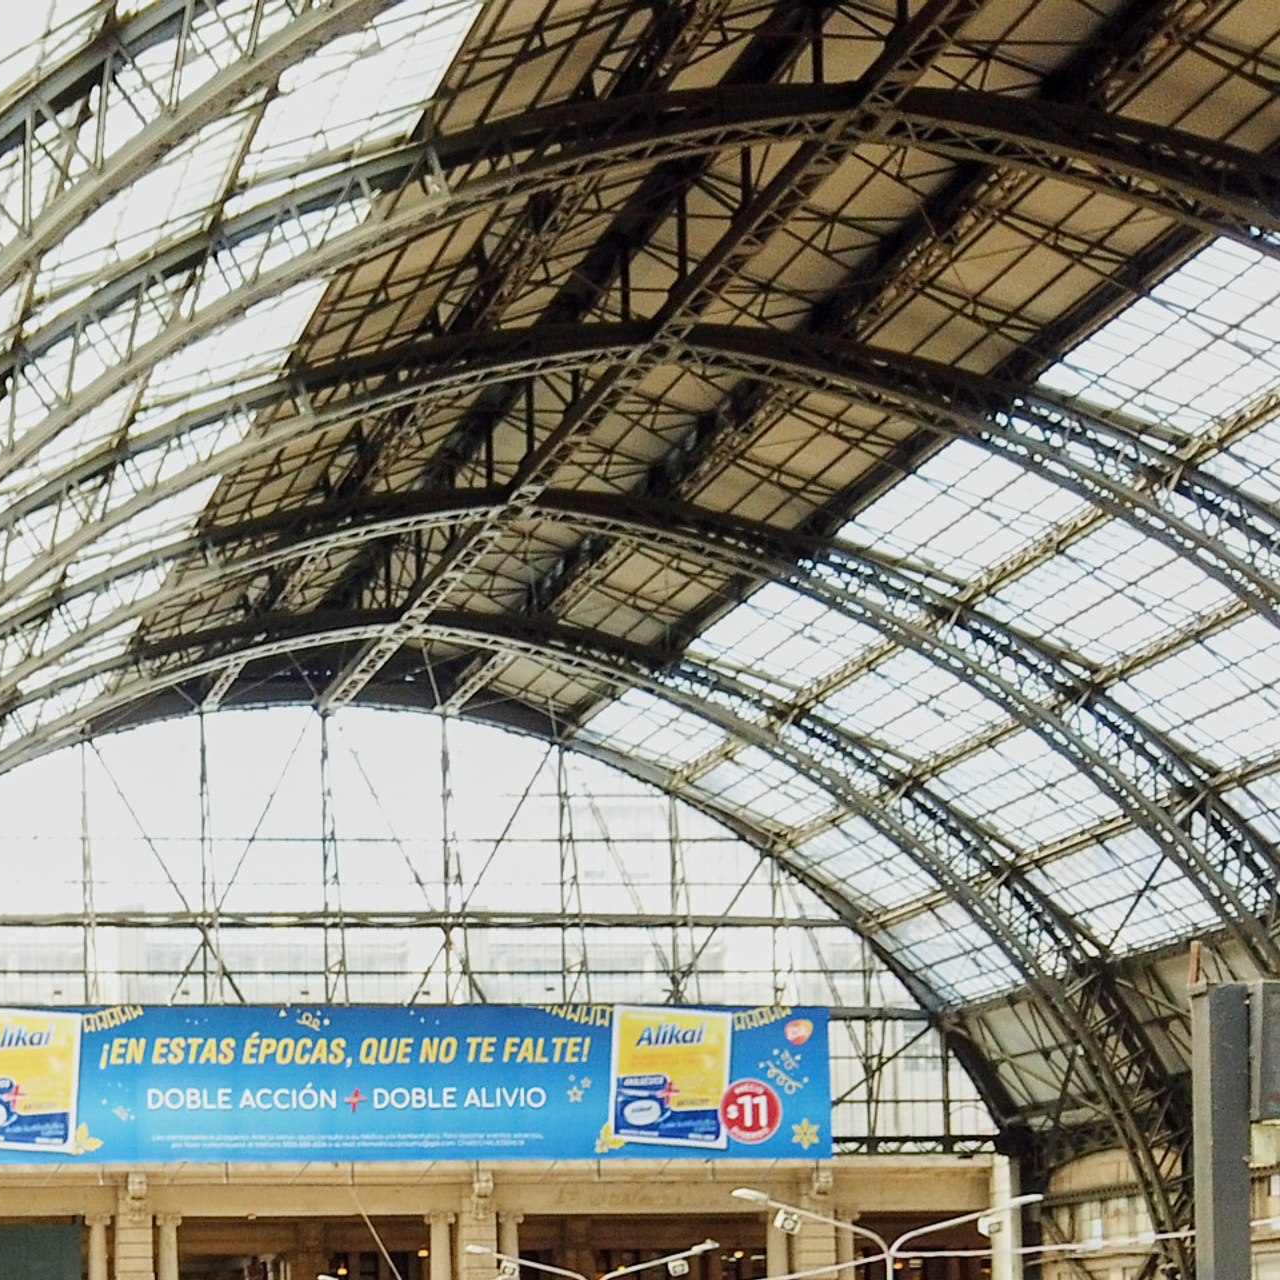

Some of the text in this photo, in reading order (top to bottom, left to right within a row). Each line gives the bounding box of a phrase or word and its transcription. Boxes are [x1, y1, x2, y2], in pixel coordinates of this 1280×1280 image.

[636, 1022, 706, 1048] Alikal
[100, 1032, 591, 1069] ¡EN ESTAS ÉPOCAS, QUE NO TE FALTE!
[147, 1089, 232, 1110] DOBLE
[239, 1083, 337, 1109] ACCIÓN
[373, 1088, 457, 1109] DOBLE
[464, 1087, 547, 1108] ALIVIO
